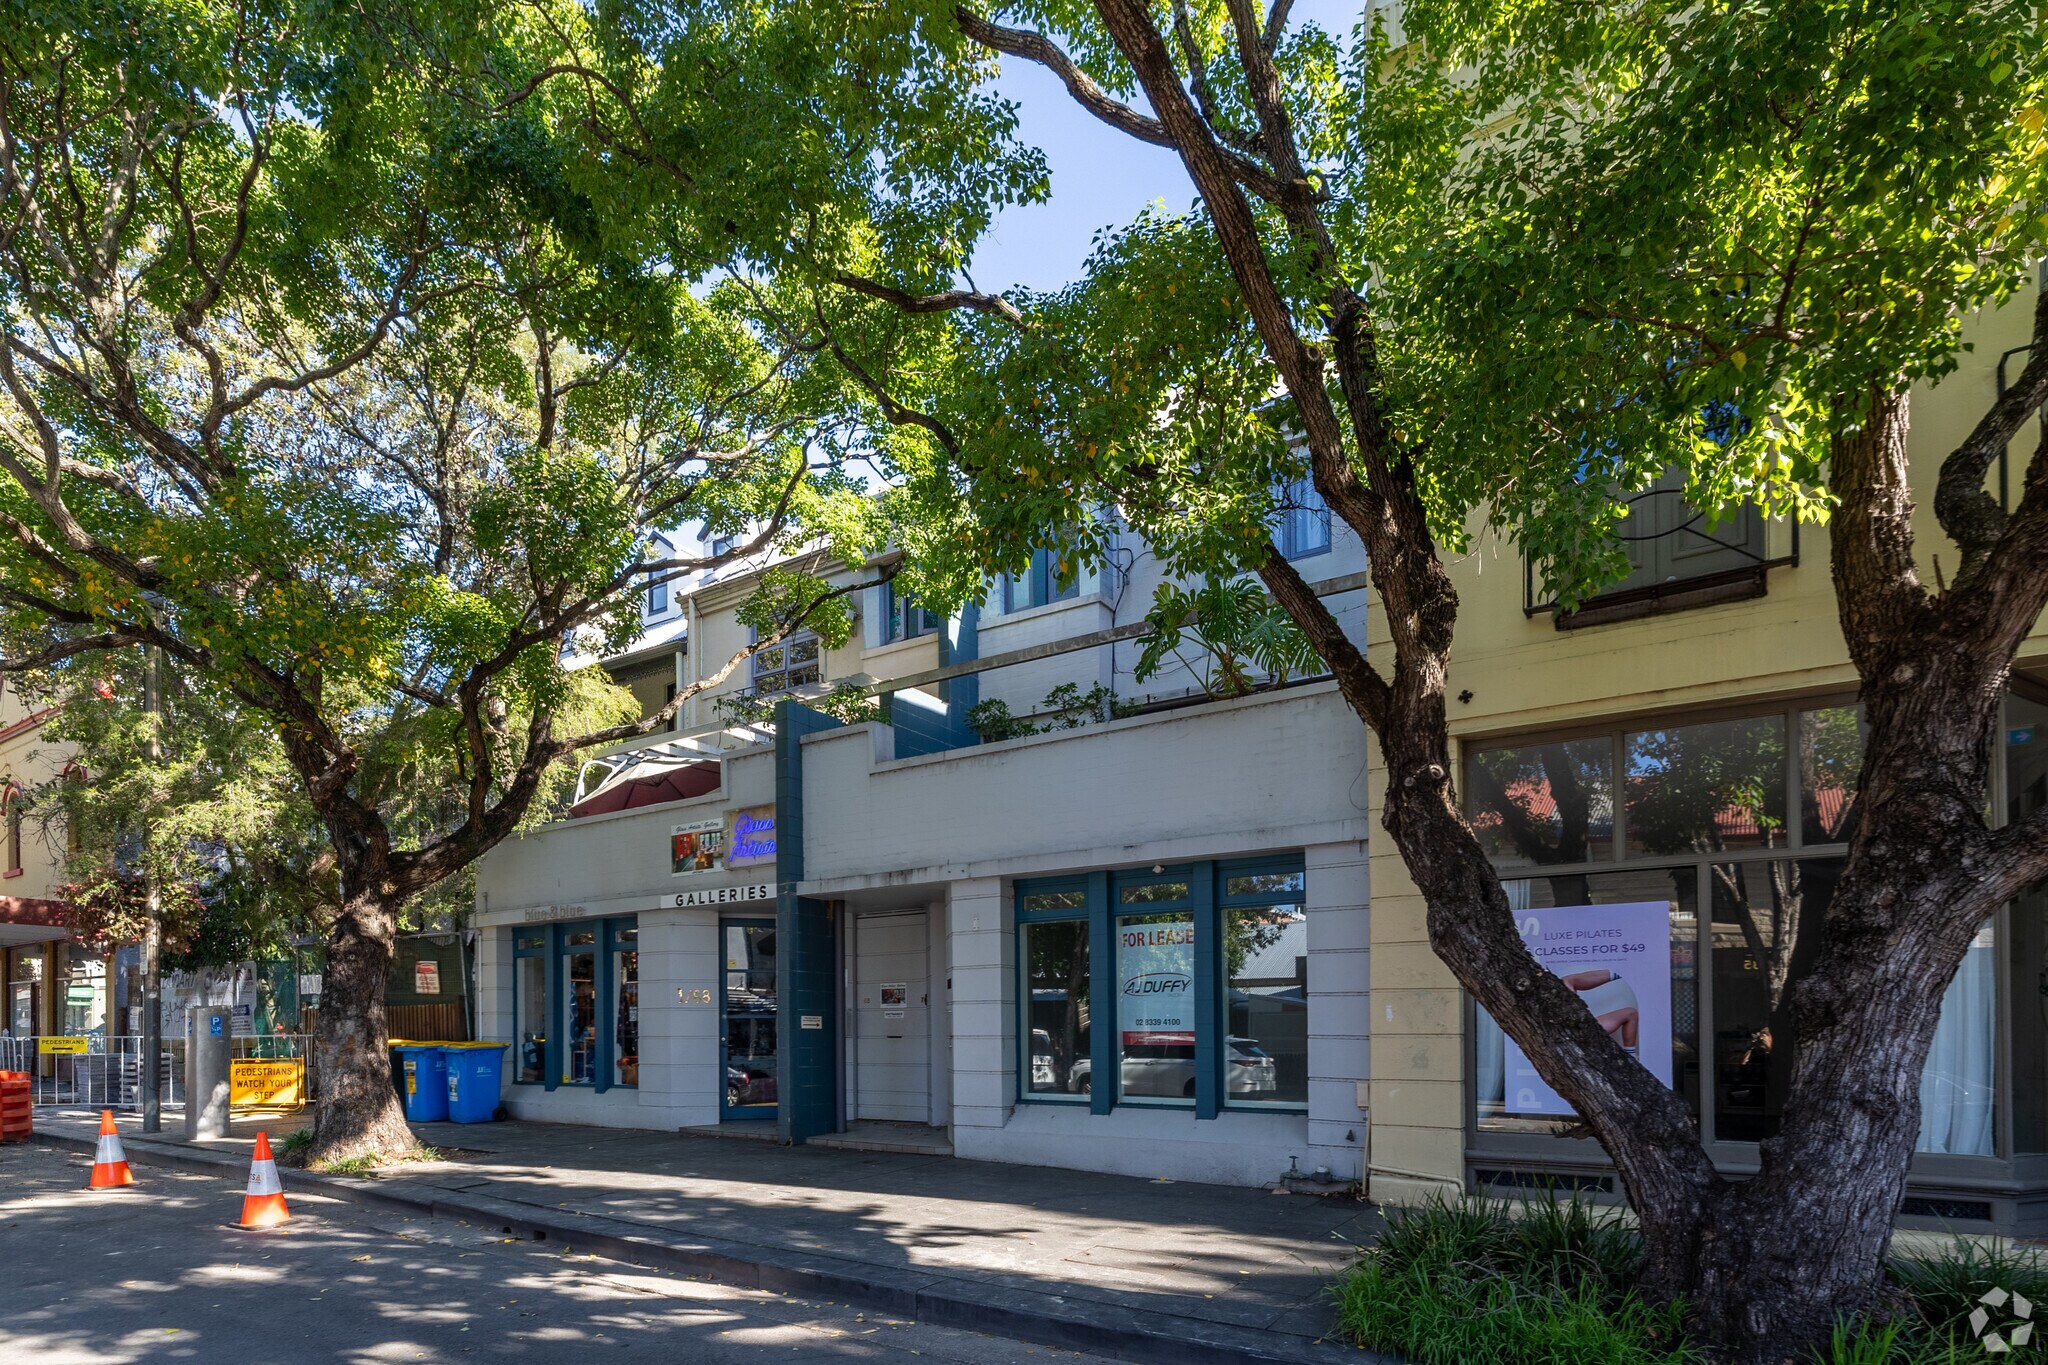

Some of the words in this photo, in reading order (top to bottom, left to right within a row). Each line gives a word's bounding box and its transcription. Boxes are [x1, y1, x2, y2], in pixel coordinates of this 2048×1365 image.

[675, 885, 767, 907] GALLERIES
[1122, 931, 1146, 947] FOR
[1149, 929, 1195, 946] LEASE
[1544, 931, 1573, 941] LUXE
[1576, 928, 1623, 939] PILATES
[1535, 945, 1589, 957] CLASSES
[1592, 945, 1618, 954] FOR
[1622, 943, 1645, 953] $49
[1143, 979, 1191, 993] DUFFY
[212, 1017, 220, 1025] P
[1135, 1018, 1143, 1026] 02
[1163, 1018, 1180, 1026] 4100
[235, 1067, 292, 1077] PEDESTRIANS
[236, 1079, 265, 1088] WATCH
[269, 1079, 292, 1088] YOUR
[254, 1091, 275, 1100] STEP
